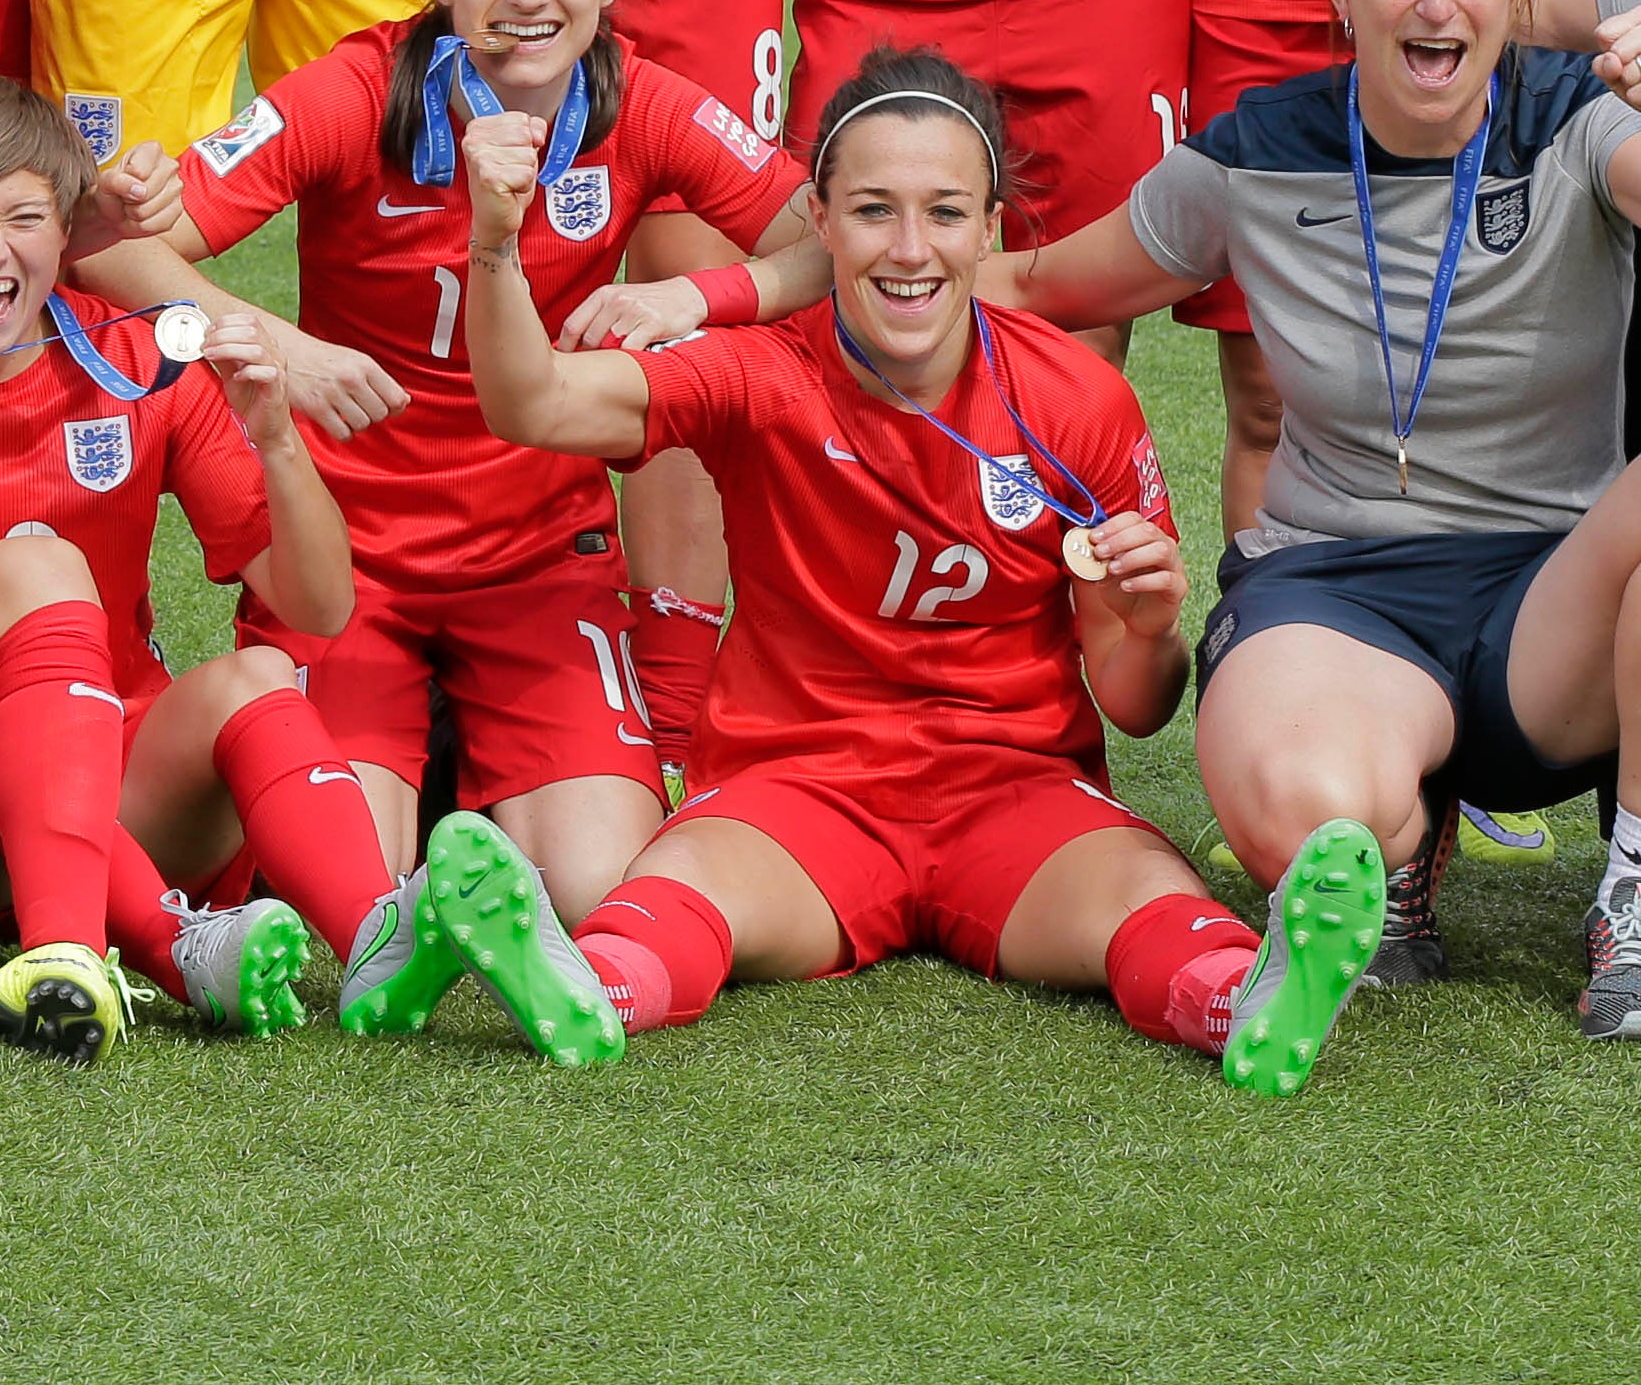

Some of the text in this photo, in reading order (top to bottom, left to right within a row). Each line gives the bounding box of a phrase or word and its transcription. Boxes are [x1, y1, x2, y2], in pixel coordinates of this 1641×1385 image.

[753, 29, 782, 140] 8
[566, 108, 578, 133] FIFA
[1464, 144, 1476, 175] FIFA
[1458, 187, 1470, 211] FIFA
[877, 530, 989, 621] 12
